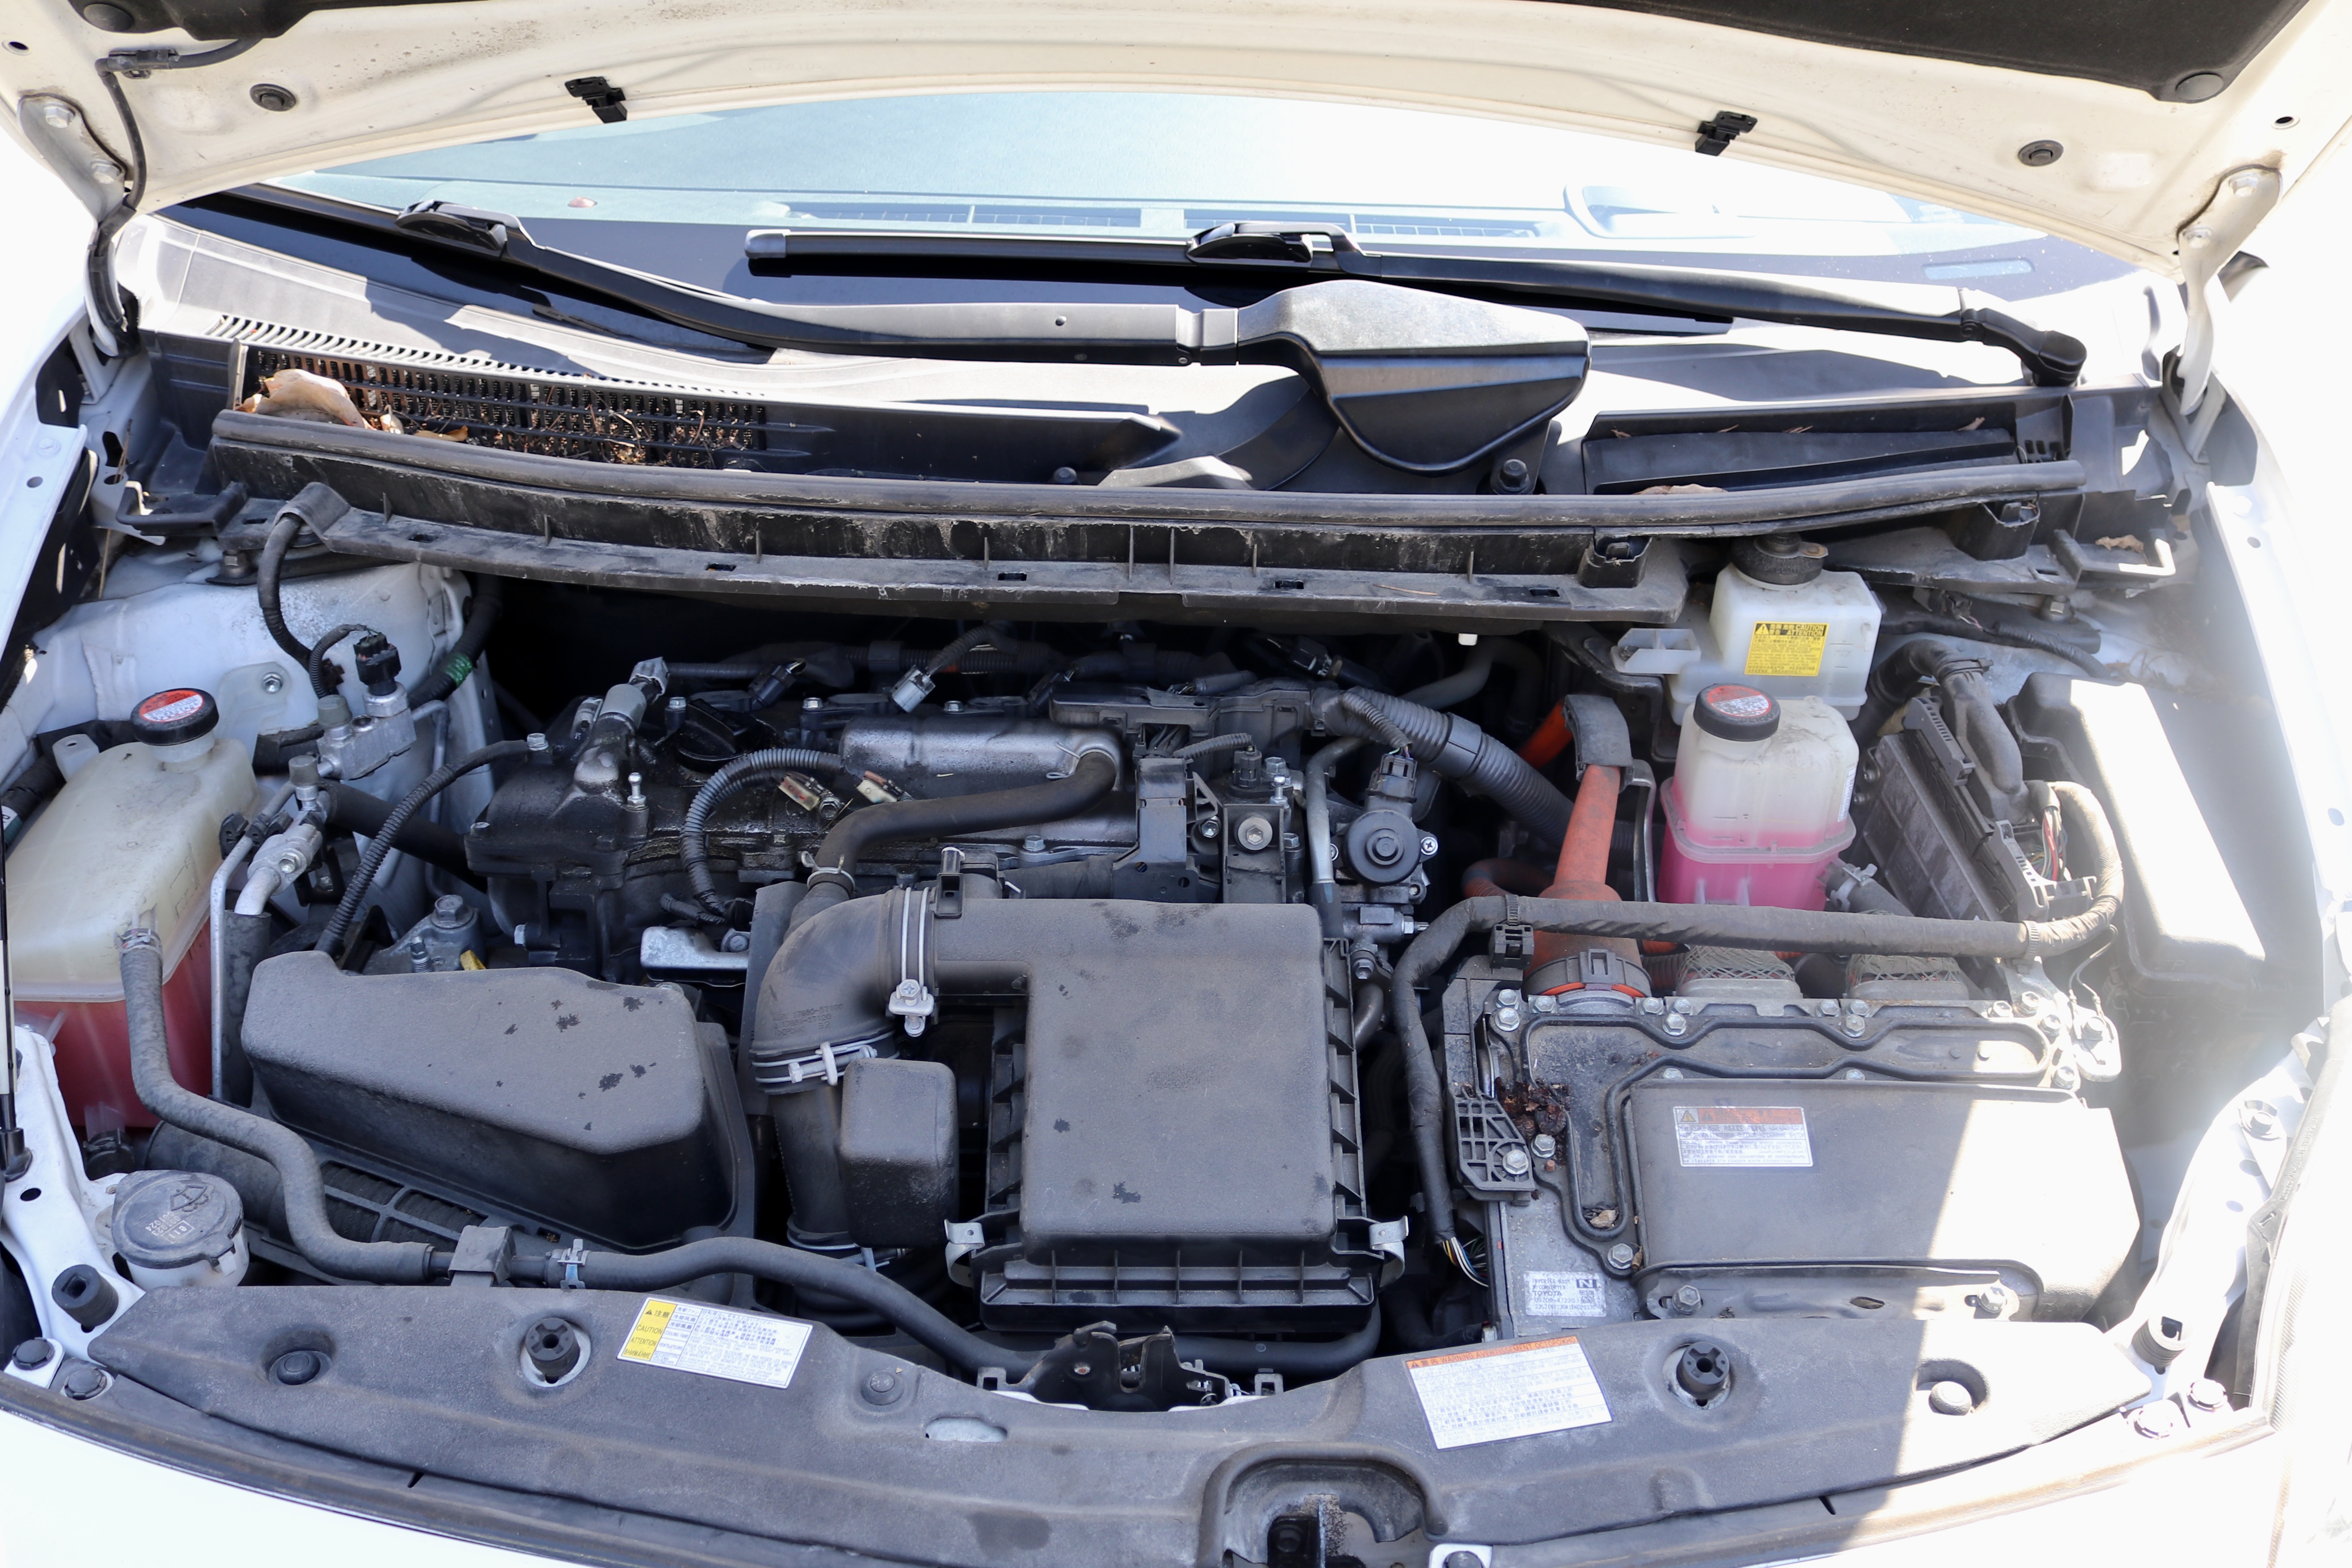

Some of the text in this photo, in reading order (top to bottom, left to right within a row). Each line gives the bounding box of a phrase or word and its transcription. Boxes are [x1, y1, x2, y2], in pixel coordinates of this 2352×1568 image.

[144, 1211, 175, 1232] 001024
[151, 1215, 181, 1236] 001023
[653, 1310, 671, 1318] 注意
[635, 1324, 664, 1334] CAUTION
[630, 1337, 658, 1346] ATTENTION
[1534, 1337, 1576, 1349] ОСТОРОЖНО
[623, 1349, 651, 1358] ВНИМАНИЕ
[1440, 1344, 1532, 1363] WARNING AVERTISSEMENT
